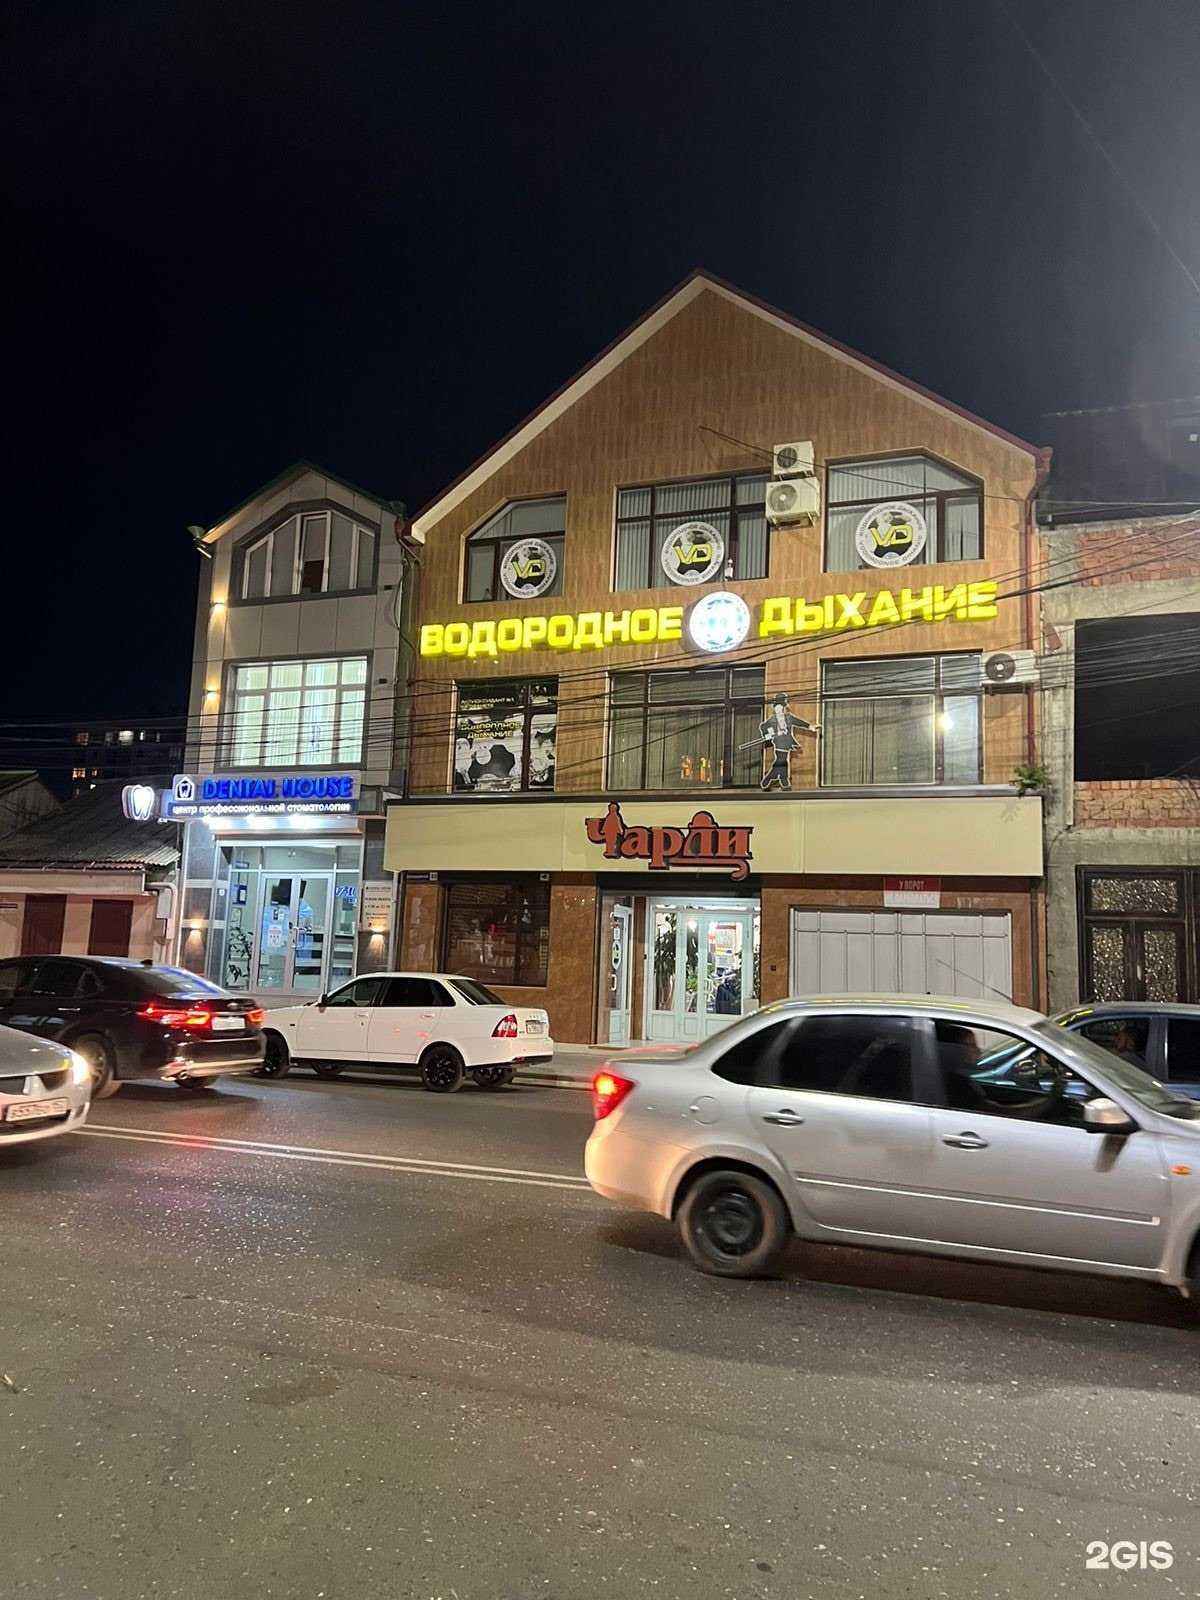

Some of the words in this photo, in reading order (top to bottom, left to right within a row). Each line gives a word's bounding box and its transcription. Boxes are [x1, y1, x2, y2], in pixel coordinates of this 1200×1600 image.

[867, 524, 913, 546] VD
[674, 543, 712, 564] VD
[511, 559, 546, 578] VD
[420, 606, 684, 657] ВОДОРОДНОЕ
[759, 581, 998, 637] ДЫХАНИЕ
[203, 778, 276, 799] DENTAL
[282, 776, 352, 798] HOUSE
[173, 805, 198, 815] центр
[287, 802, 351, 813] стоматологии
[585, 800, 753, 881] Чарли
